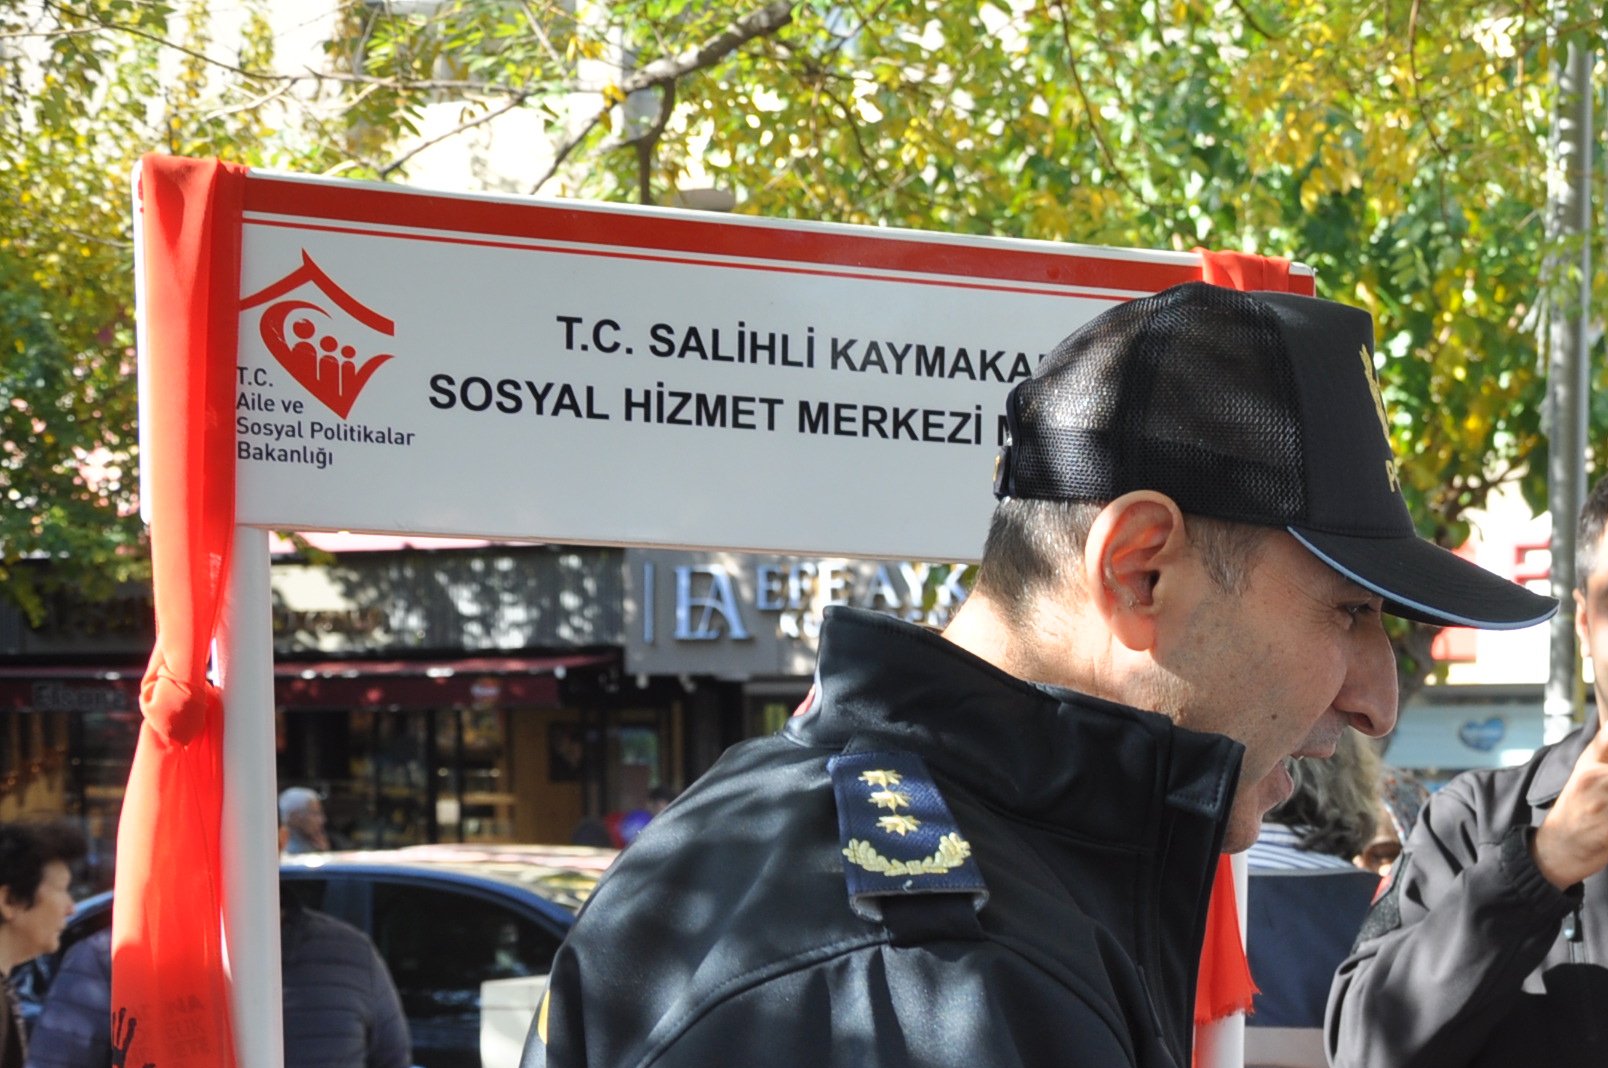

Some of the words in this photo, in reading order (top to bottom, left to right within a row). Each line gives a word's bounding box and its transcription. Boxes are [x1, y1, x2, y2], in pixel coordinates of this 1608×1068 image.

[556, 315, 633, 354] T.C.
[649, 320, 815, 368] SALİHLİ
[830, 336, 1050, 383] KAYMAKA
[237, 366, 273, 387] T.C.
[236, 392, 275, 413] Aile
[282, 399, 304, 414] ve
[428, 374, 610, 420] SOSYAL
[624, 381, 784, 431] HİZMET
[798, 400, 982, 446] MERKEZİ
[236, 416, 304, 441] Sosyal
[310, 421, 416, 446] Politikalar
[237, 441, 333, 469] Bakanlığı
